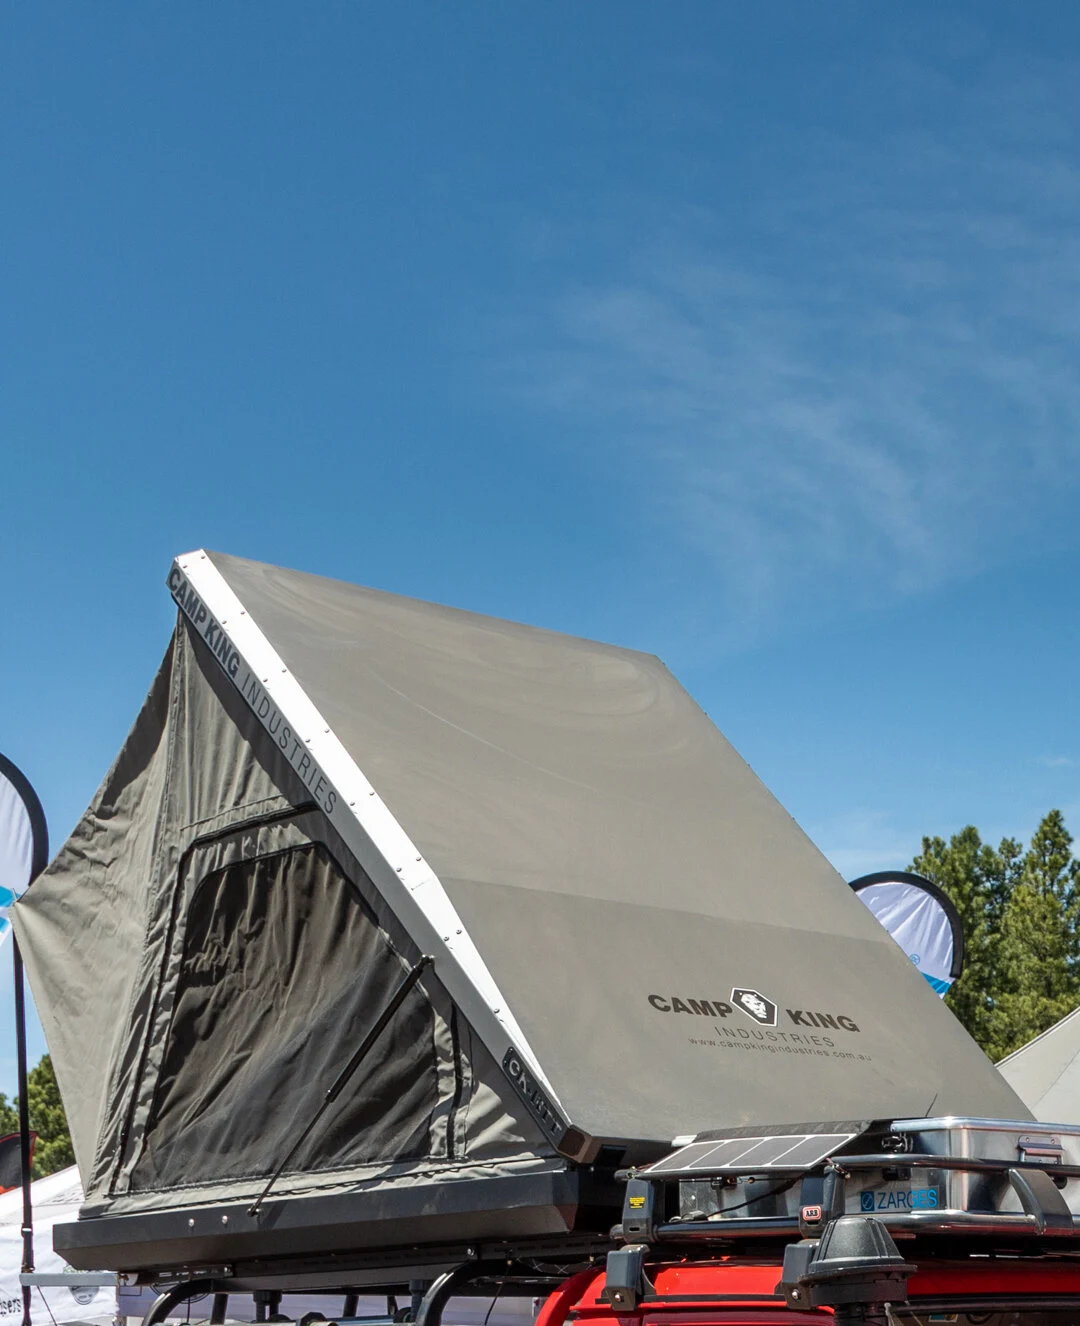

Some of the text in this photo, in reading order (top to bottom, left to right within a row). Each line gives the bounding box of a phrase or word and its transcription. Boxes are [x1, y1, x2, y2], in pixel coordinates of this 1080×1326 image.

[169, 568, 337, 814] CAMP KING INDUSTRIES
[647, 994, 861, 1032] CAMP KING
[714, 1026, 835, 1047] INDUSTRIES
[877, 1189, 938, 1210] ZARGES
